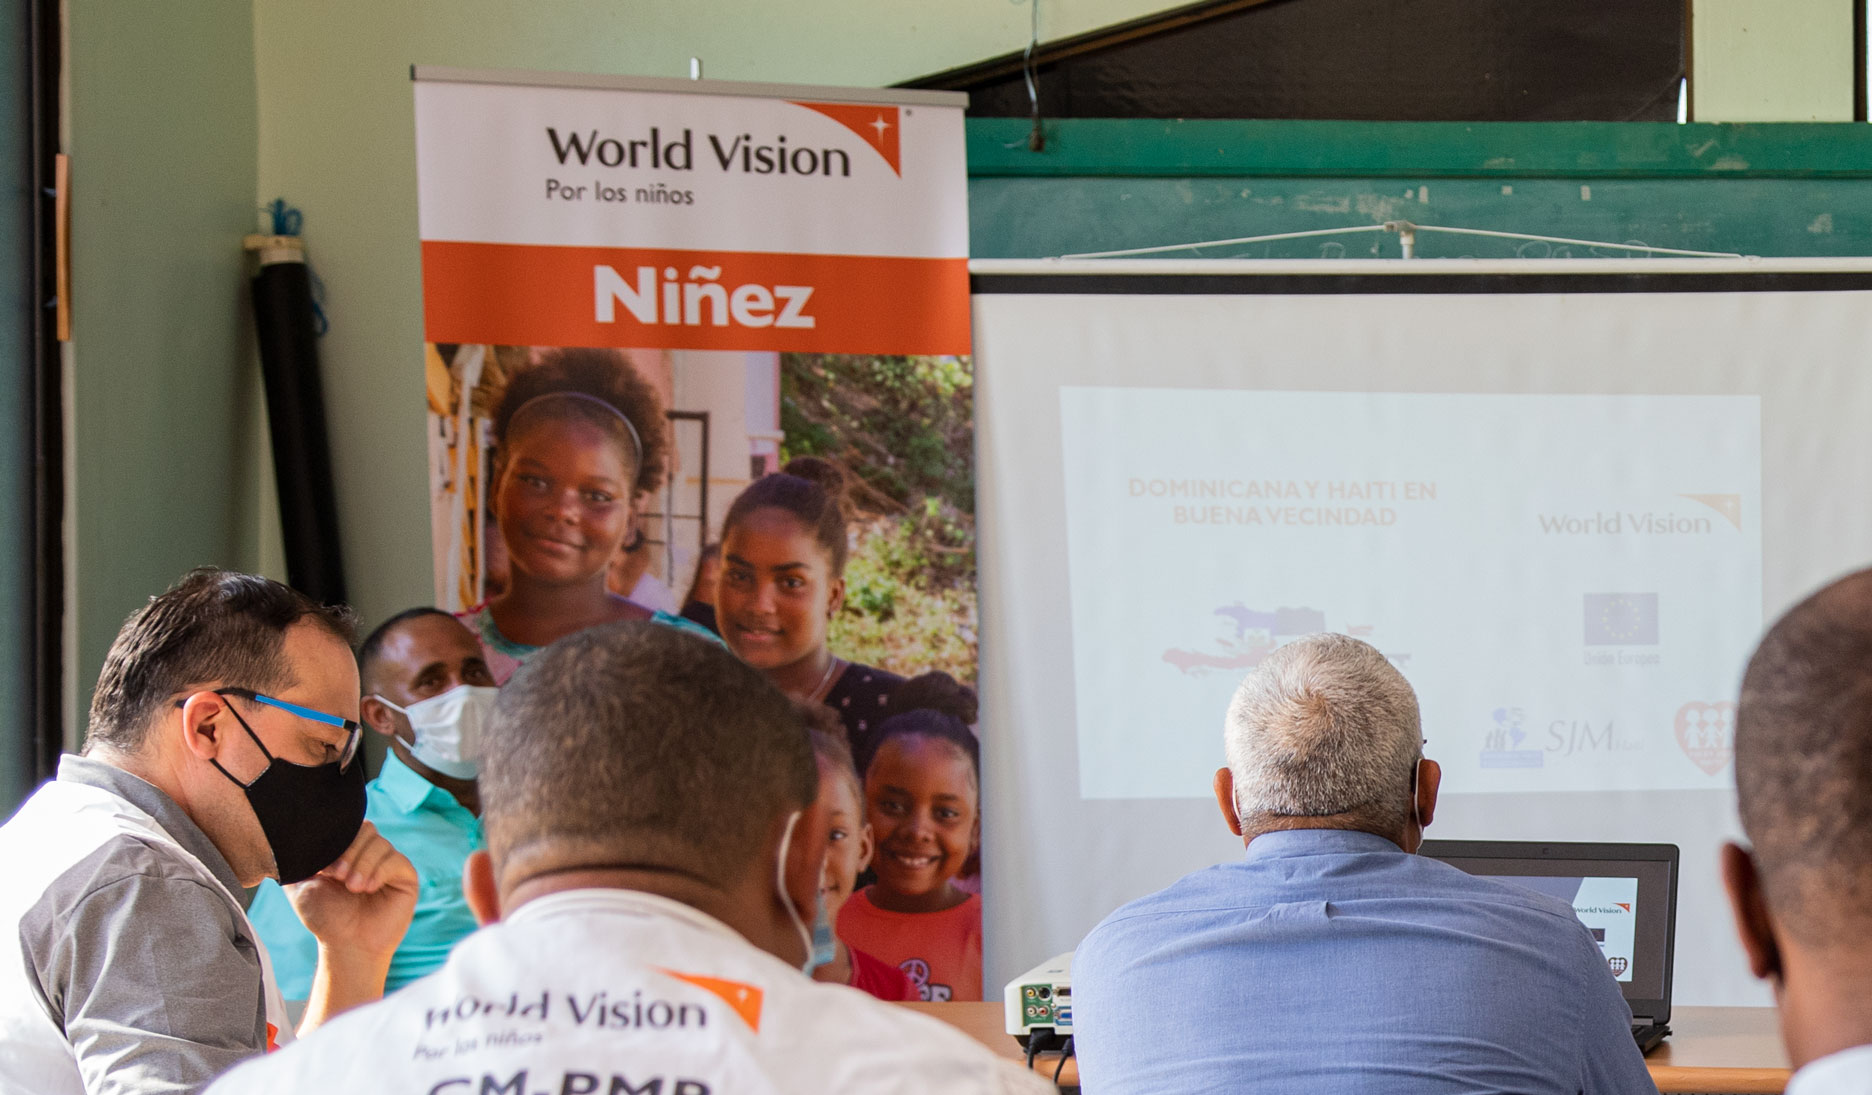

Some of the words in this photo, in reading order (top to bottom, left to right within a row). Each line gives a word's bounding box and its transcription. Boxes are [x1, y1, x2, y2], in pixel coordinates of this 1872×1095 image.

[546, 127, 694, 171] World
[708, 134, 851, 177] Vision
[546, 179, 587, 202] Por
[595, 181, 626, 203] los
[635, 182, 694, 205] niños
[594, 265, 815, 328] Niñez
[1128, 478, 1302, 499] DOMINICANA
[1328, 480, 1397, 500] HAITI
[1404, 482, 1438, 501] EN
[1173, 505, 1262, 525] BUENA
[1265, 506, 1397, 526] VECINDAD
[1538, 511, 1622, 535] World
[1627, 512, 1712, 535] Vision
[1545, 720, 1614, 757] SJM
[566, 990, 707, 1031] Vision
